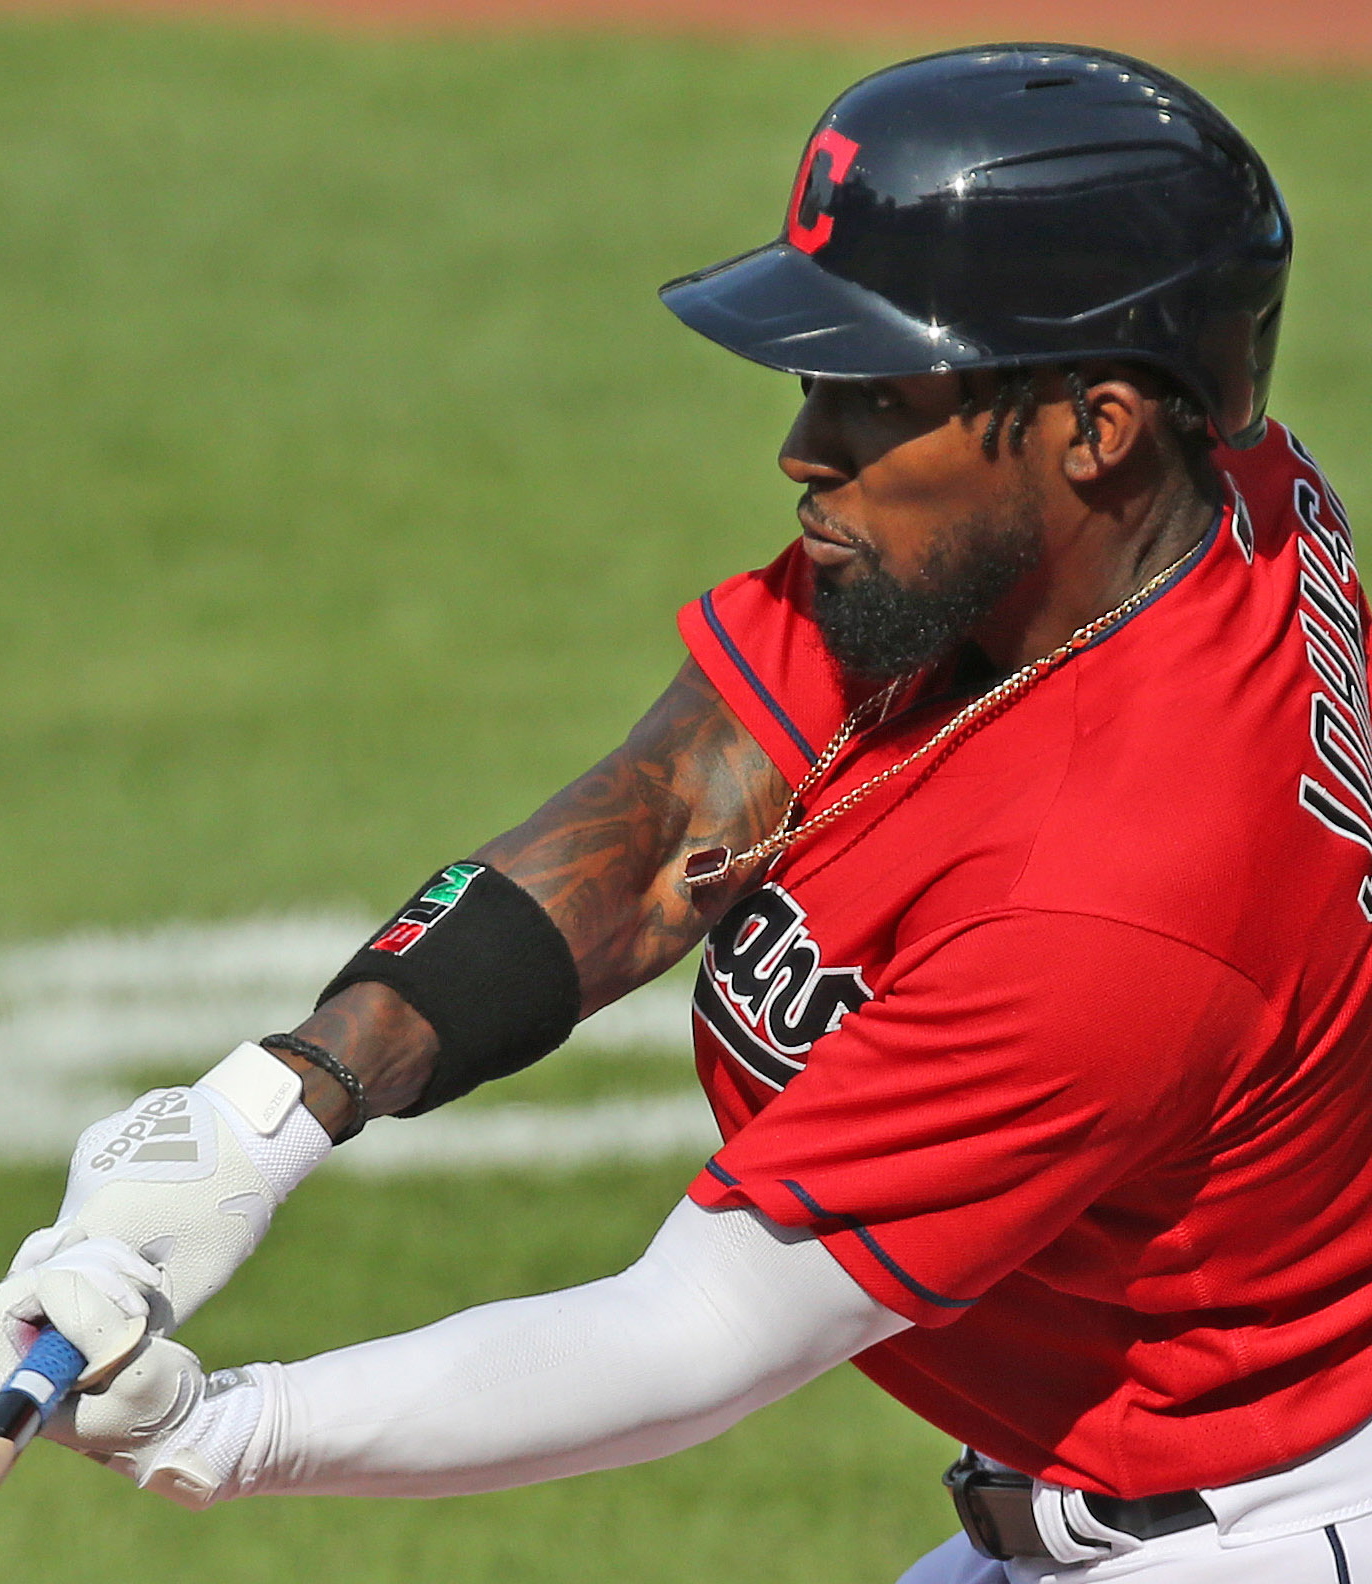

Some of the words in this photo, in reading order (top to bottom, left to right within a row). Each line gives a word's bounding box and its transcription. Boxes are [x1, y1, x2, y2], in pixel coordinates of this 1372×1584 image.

[787, 128, 860, 256] C
[369, 864, 486, 957] BLM
[90, 1091, 185, 1172] adidas
